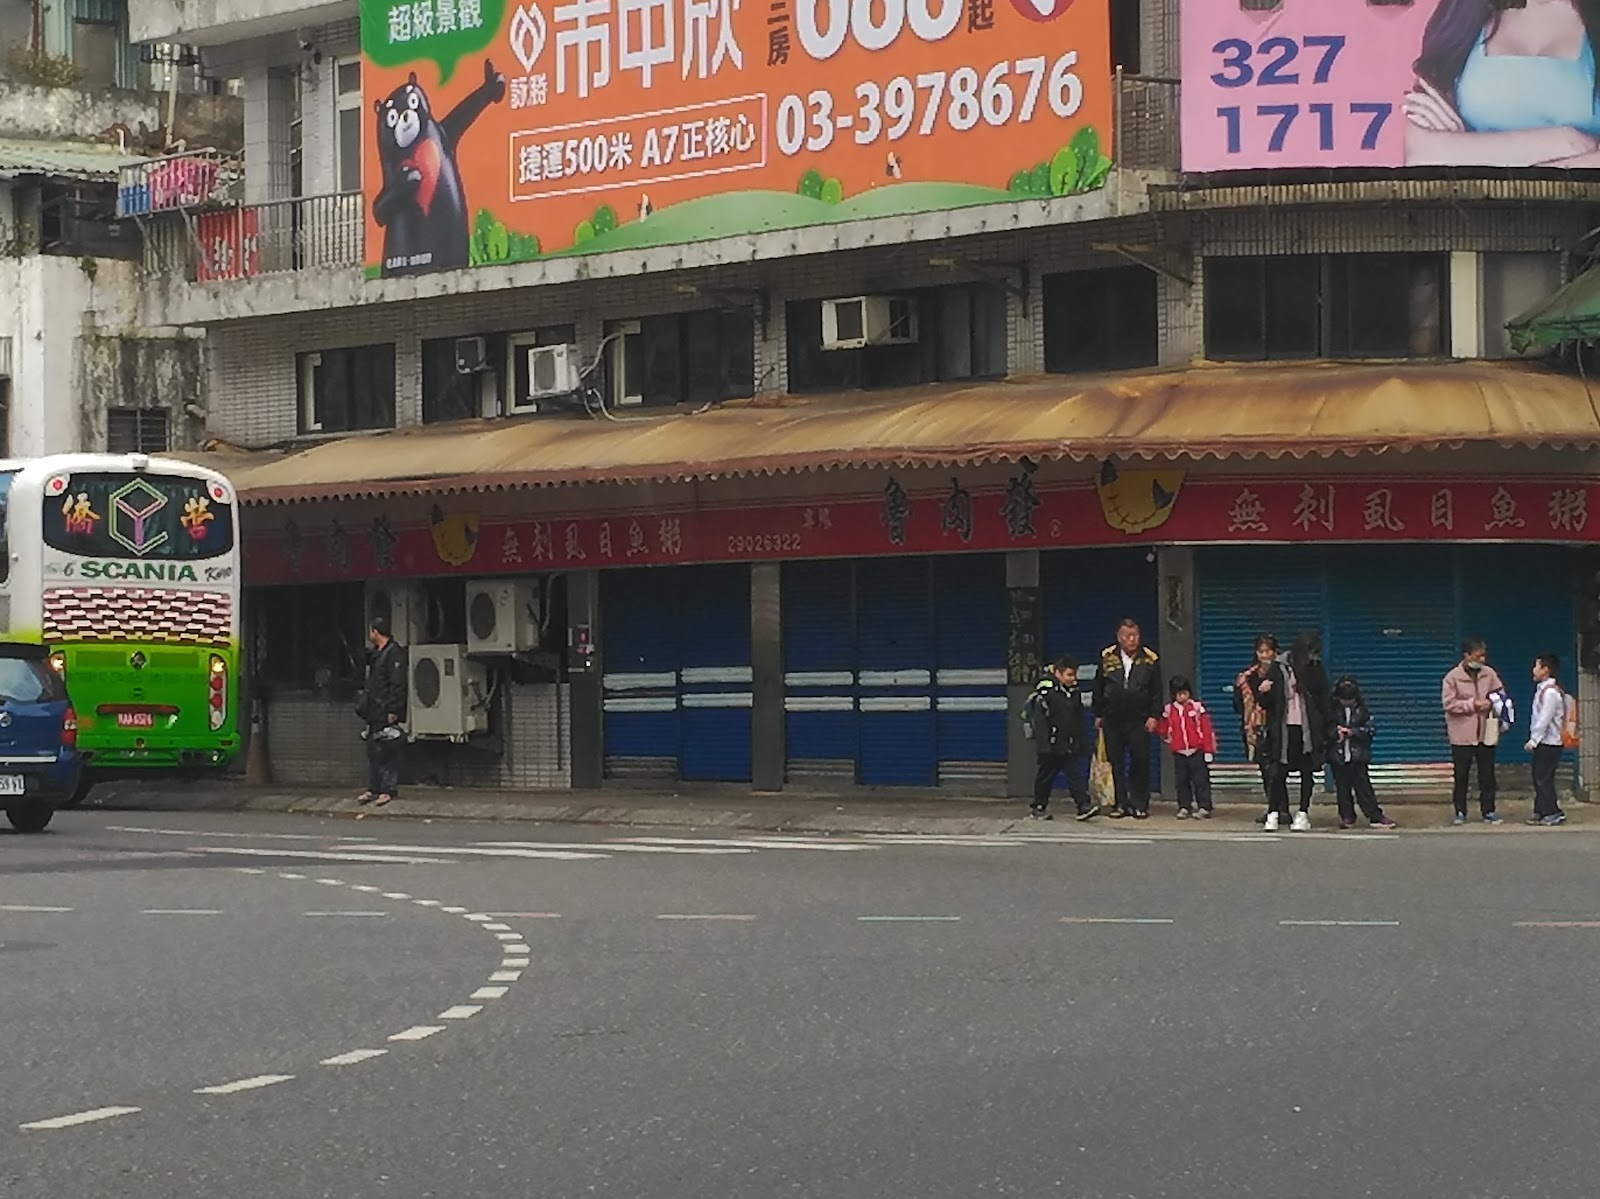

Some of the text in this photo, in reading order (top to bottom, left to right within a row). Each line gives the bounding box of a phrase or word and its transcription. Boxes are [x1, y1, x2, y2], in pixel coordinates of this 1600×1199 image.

[388, 0, 483, 44] 超級景觀
[1210, 35, 1346, 87] 327
[776, 50, 1083, 155] 03-3978676
[519, 113, 756, 184] 捷運500米 A7正核心
[1217, 103, 1393, 153] 1717
[1228, 484, 1588, 533] 無刺虱目魚粥
[728, 533, 800, 553] 29026322
[80, 560, 198, 582] SCANIA
